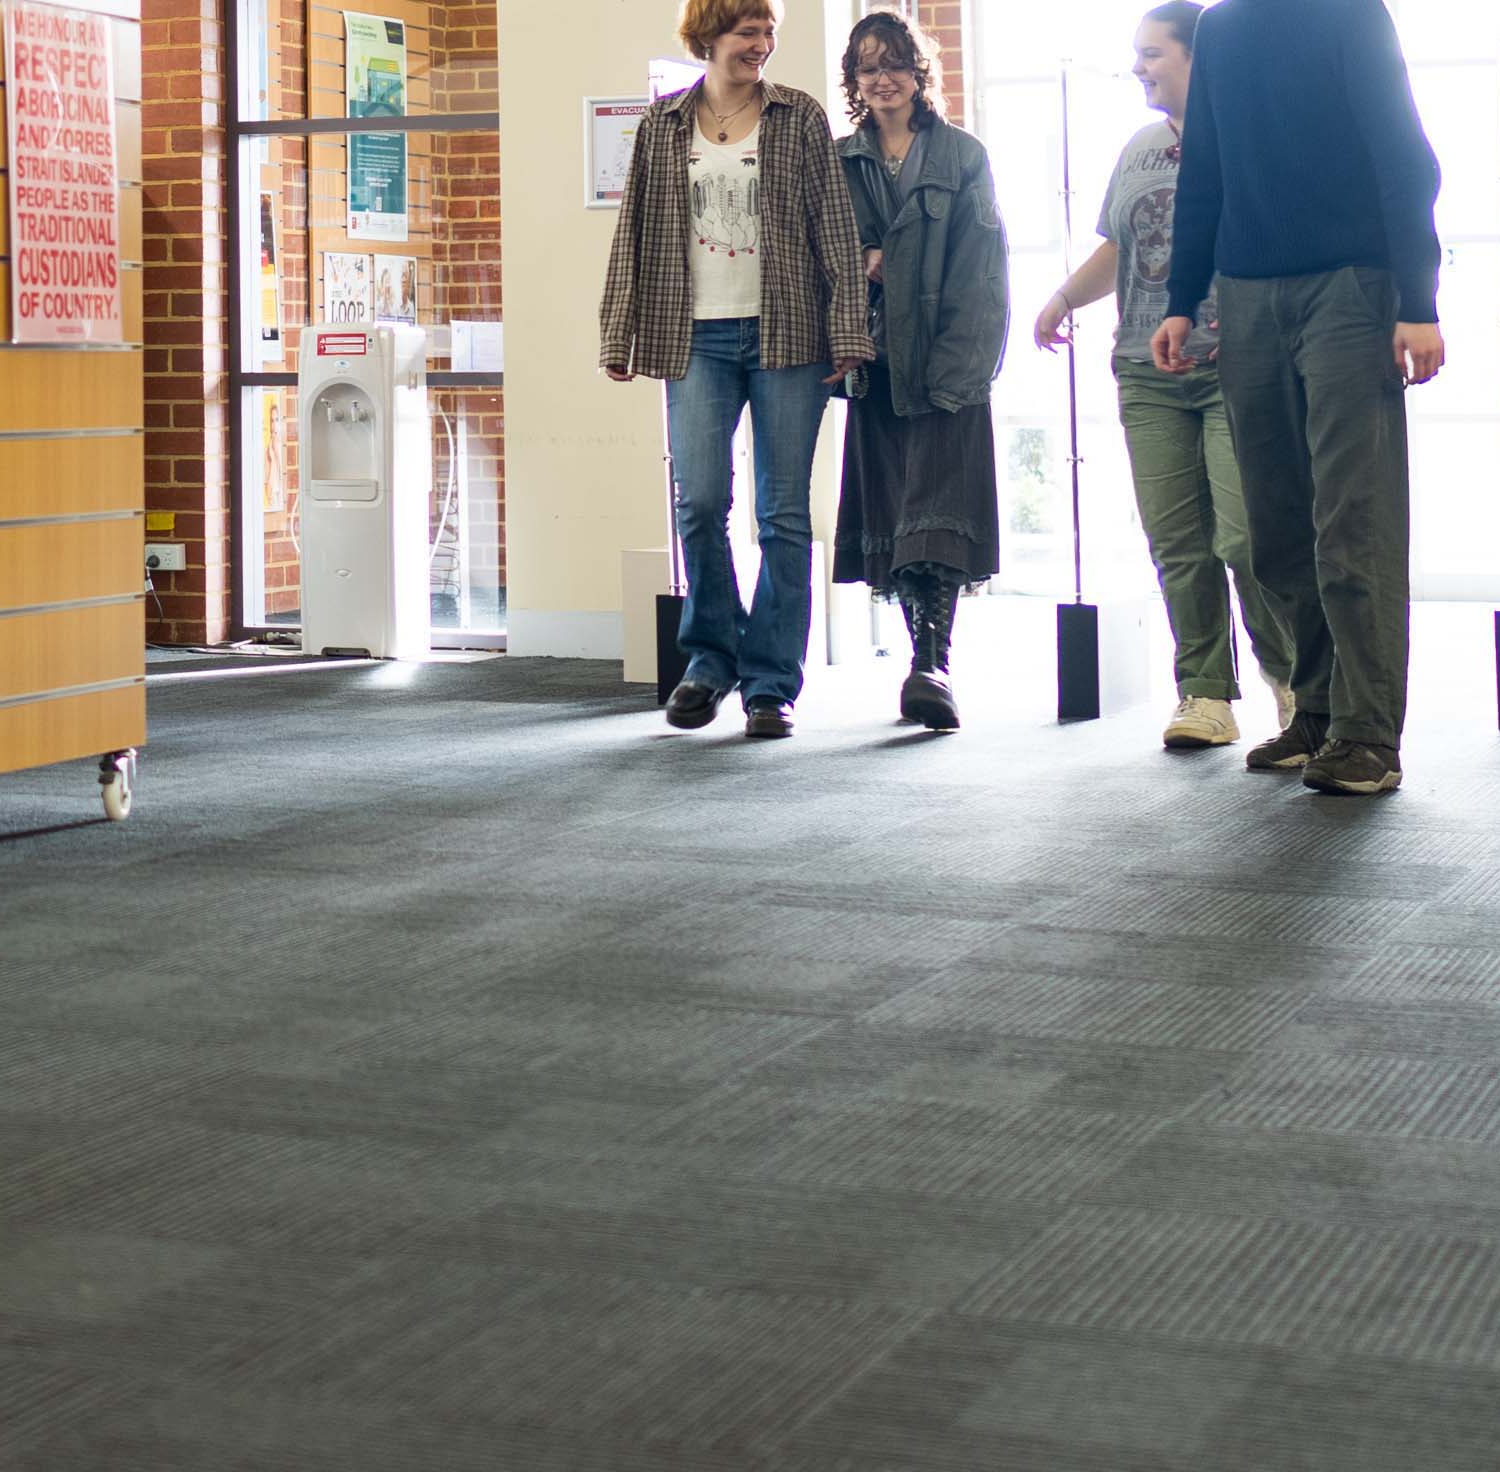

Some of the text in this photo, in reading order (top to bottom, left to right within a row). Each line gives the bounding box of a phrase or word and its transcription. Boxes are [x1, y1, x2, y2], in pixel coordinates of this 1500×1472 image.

[14, 9, 107, 49] WE HONOUR AN
[14, 42, 108, 92] RESPECT
[15, 86, 110, 126] ABORIGINAL
[16, 123, 50, 150] AND
[16, 155, 57, 181] STRAIT
[16, 186, 115, 214] PEOPLE AS THE
[17, 212, 116, 246] TRADITIONAL
[18, 247, 117, 289] CUSTODIANS
[19, 292, 118, 320] OF COUNTRY.
[331, 300, 365, 323] LOOP
